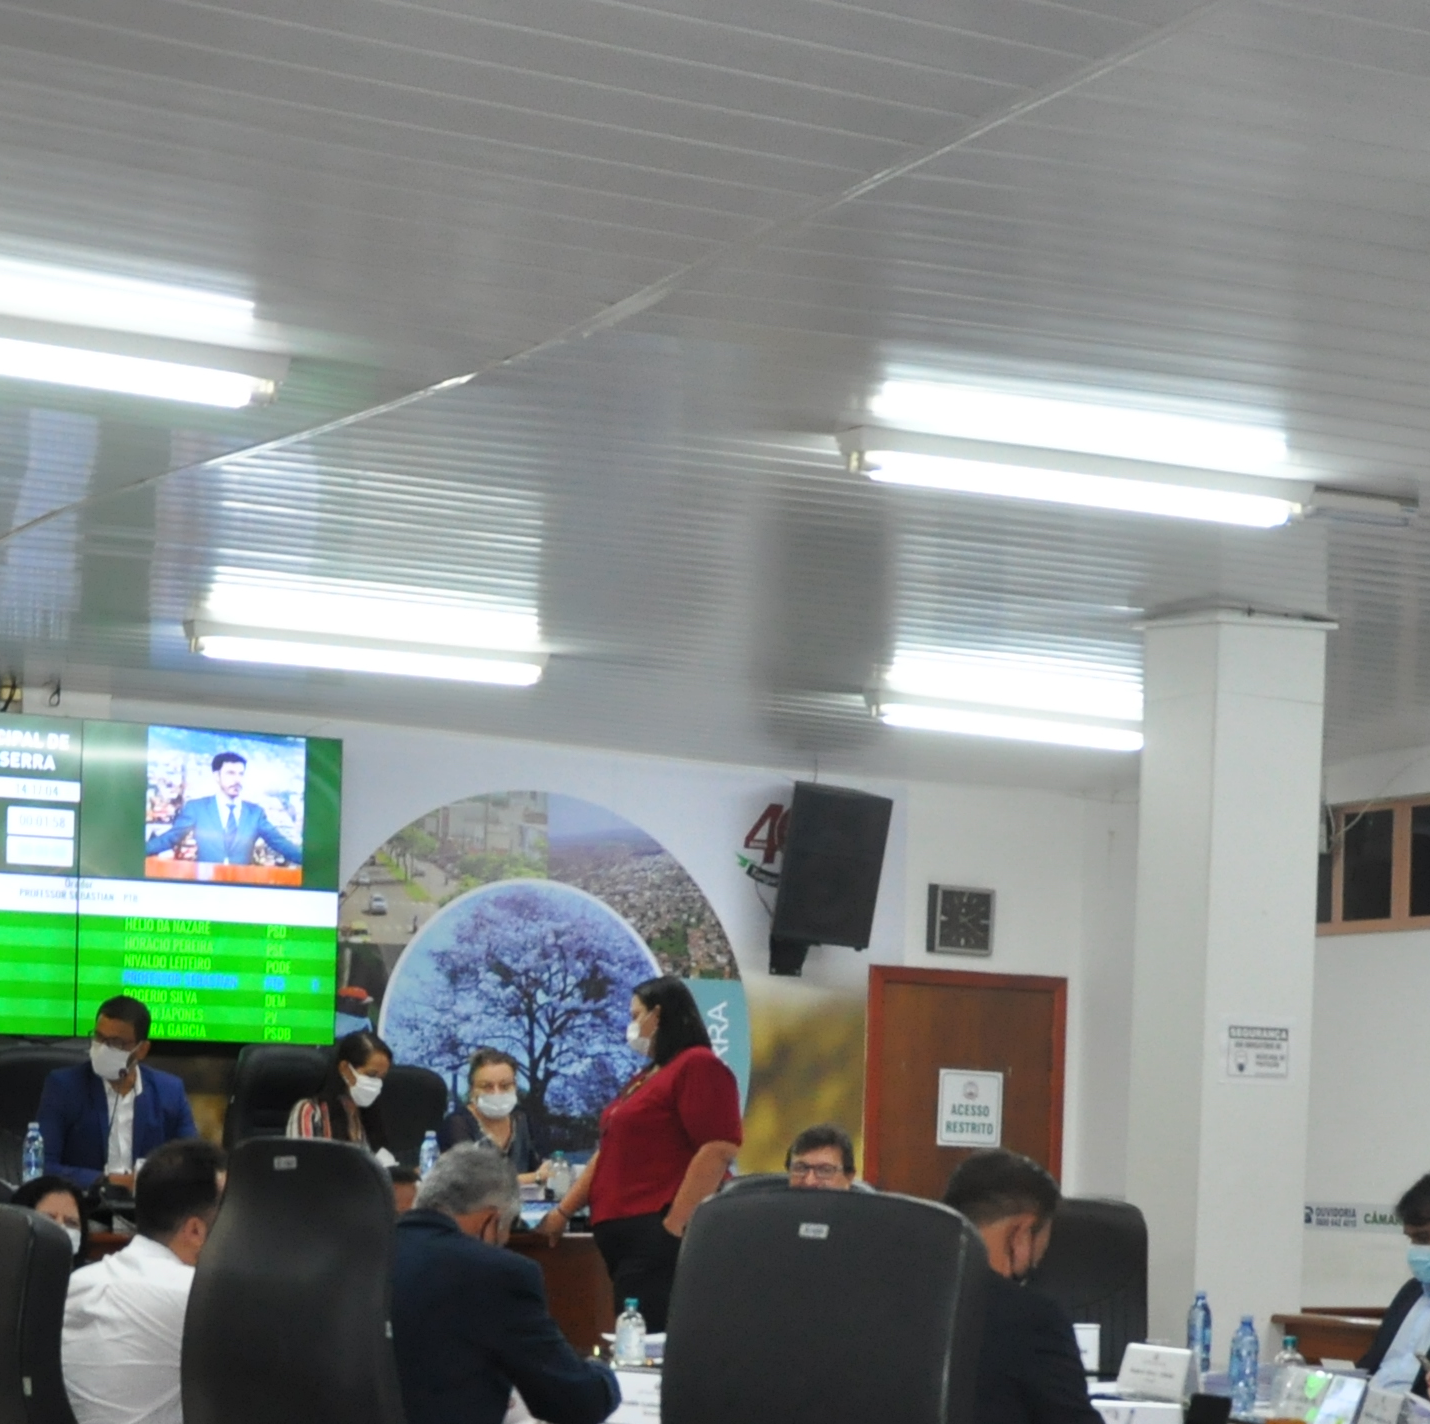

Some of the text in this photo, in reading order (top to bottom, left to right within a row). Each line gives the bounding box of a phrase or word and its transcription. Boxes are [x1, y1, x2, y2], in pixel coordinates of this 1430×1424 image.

[47, 733, 70, 750] DE
[156, 919, 172, 935] DA
[123, 954, 168, 969] NIVALDO
[265, 960, 291, 975] PODE
[169, 990, 198, 1005] SILVA
[264, 993, 287, 1008] DEM
[264, 1026, 292, 1041] PSDB
[951, 1103, 990, 1117] ACESSO
[945, 1121, 994, 1135] RESTRITO
[1363, 1210, 1404, 1225] CÂMA
